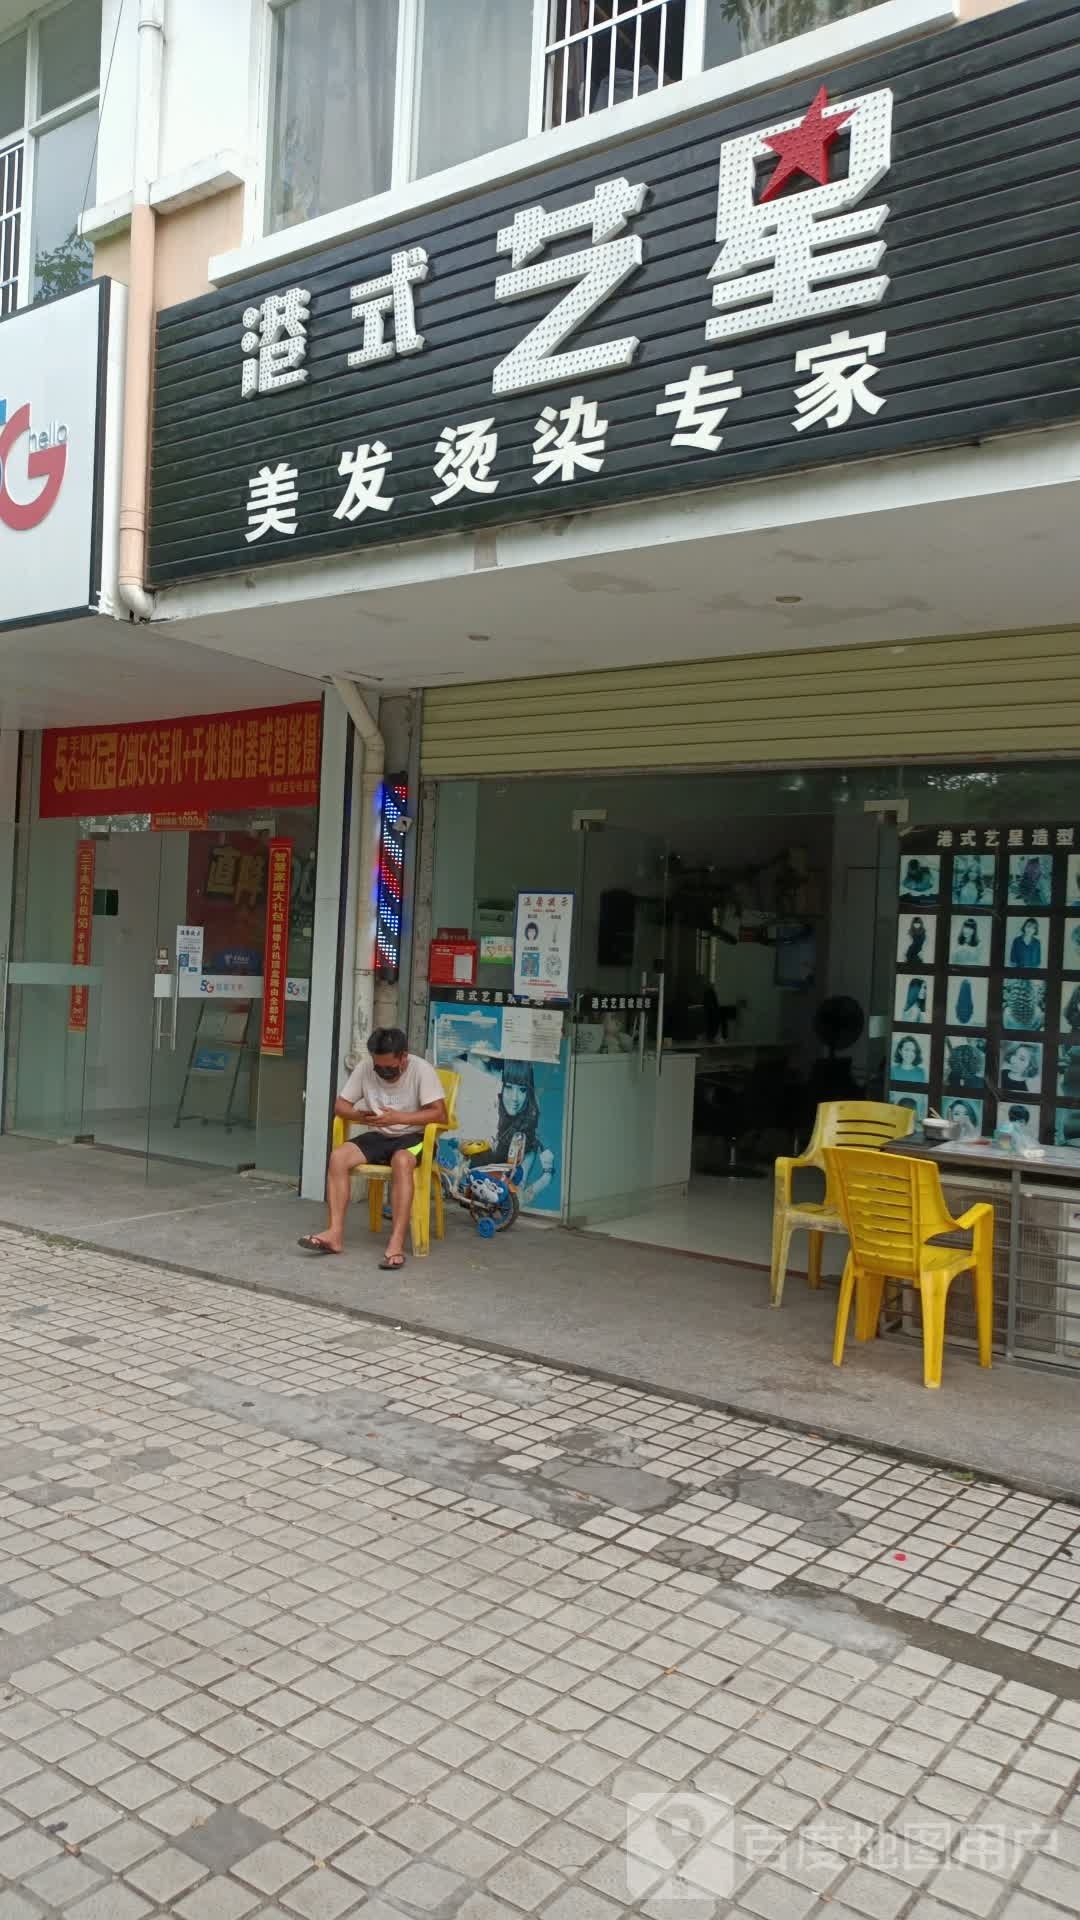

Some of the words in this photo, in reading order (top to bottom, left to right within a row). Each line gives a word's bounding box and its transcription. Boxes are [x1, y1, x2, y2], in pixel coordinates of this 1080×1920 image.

[240, 86, 893, 397] 港式艺星
[0, 399, 68, 531] G
[29, 419, 69, 453] hello
[244, 329, 888, 543] 美发烫染专家
[936, 828, 1075, 847] 港式艺星造型
